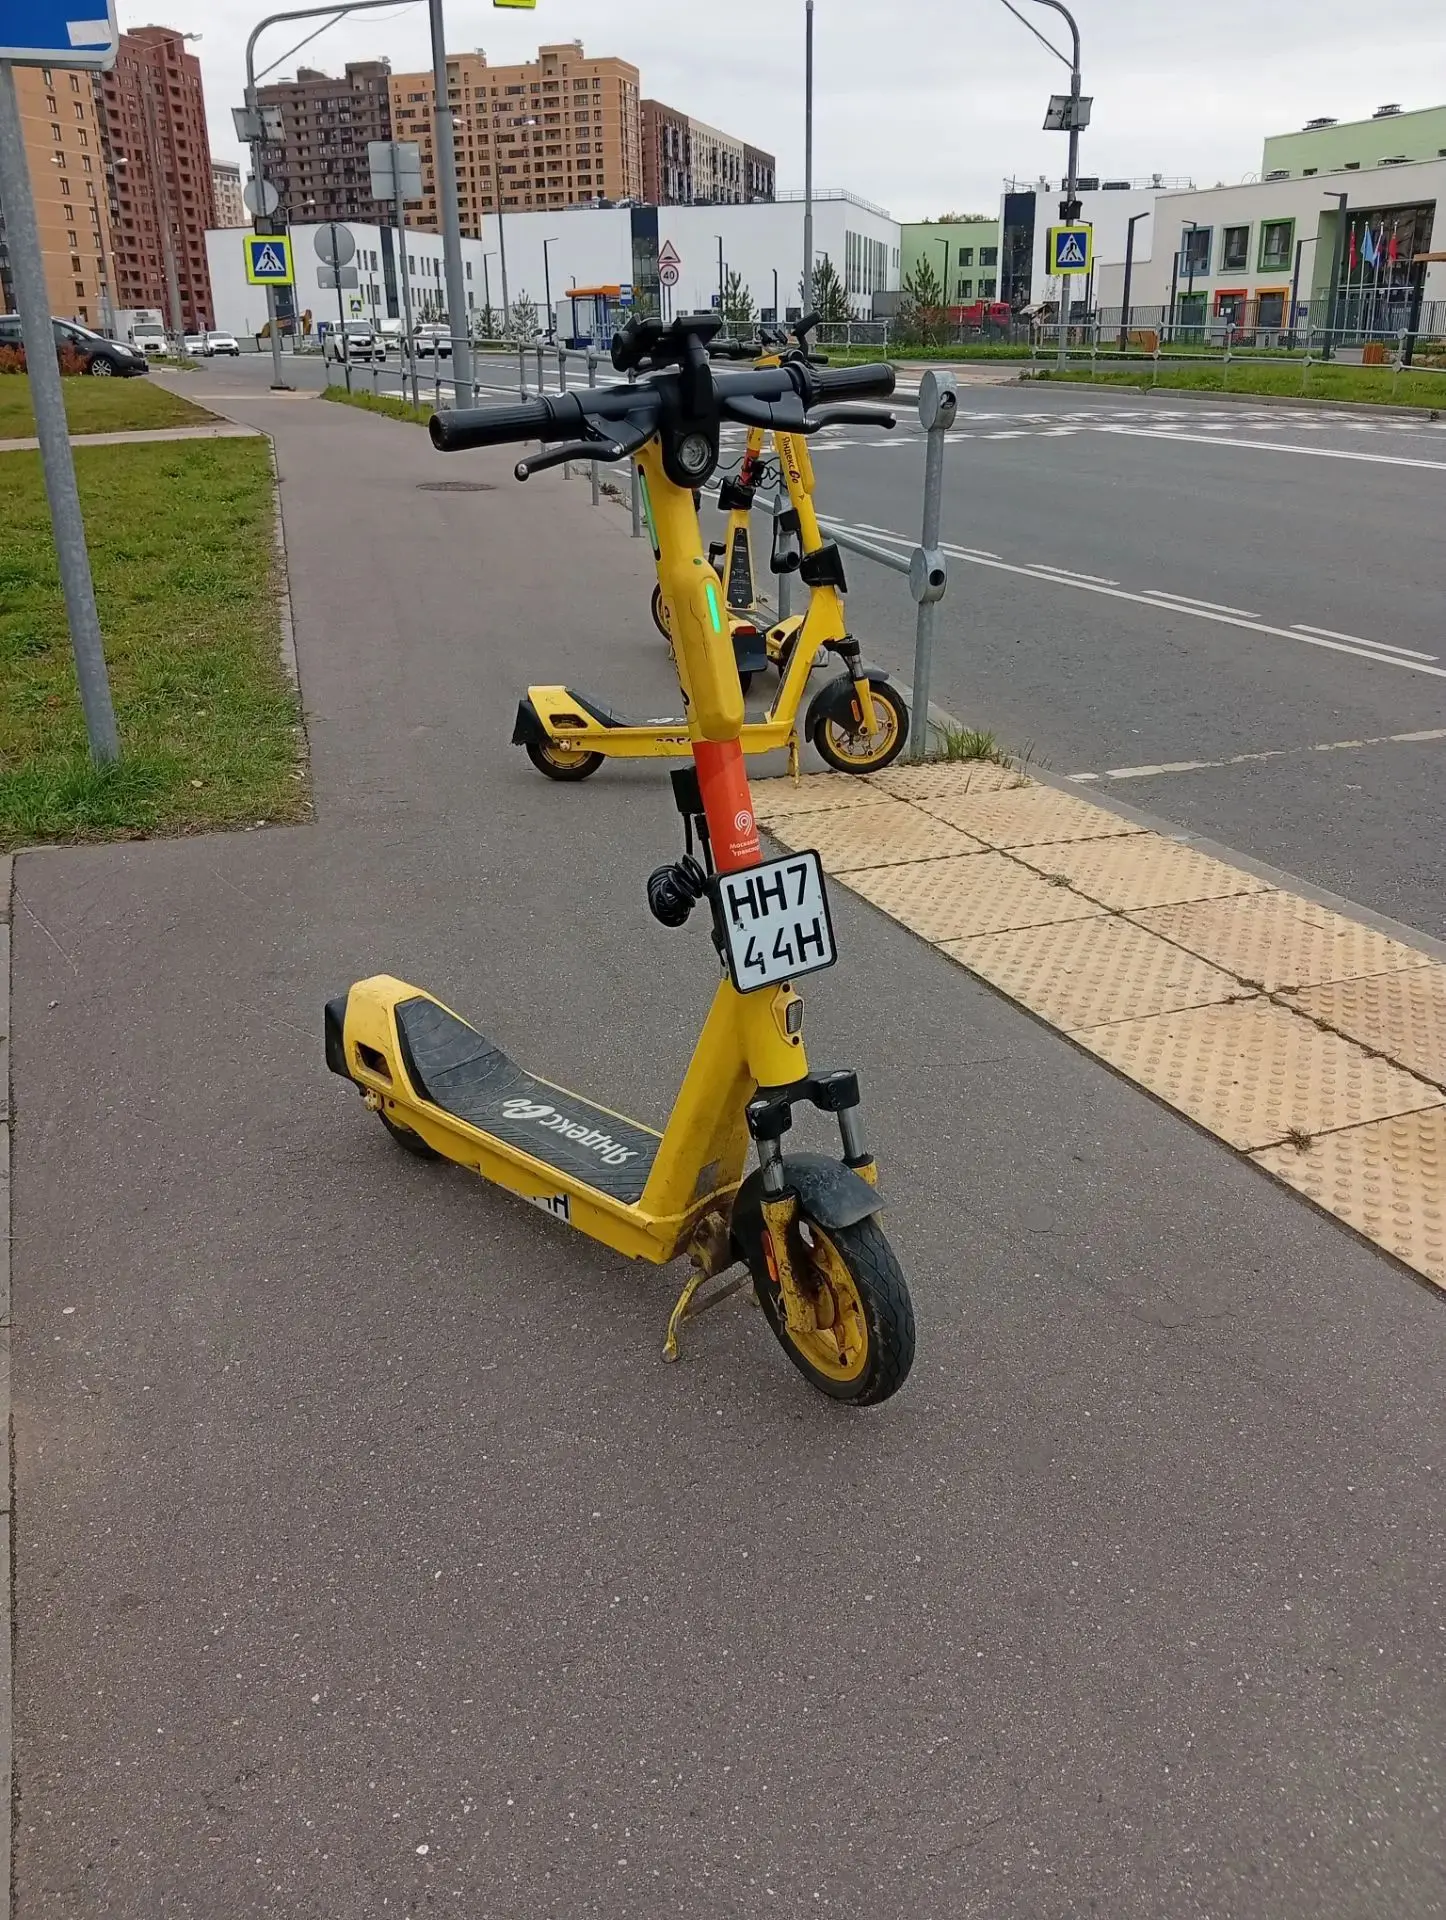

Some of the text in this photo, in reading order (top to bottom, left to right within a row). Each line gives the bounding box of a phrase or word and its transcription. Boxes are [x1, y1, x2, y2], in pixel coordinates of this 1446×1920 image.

[663, 270, 675, 280] 40
[781, 436, 801, 484] Яндекс Go
[502, 1098, 640, 1165] Яндекс Go
